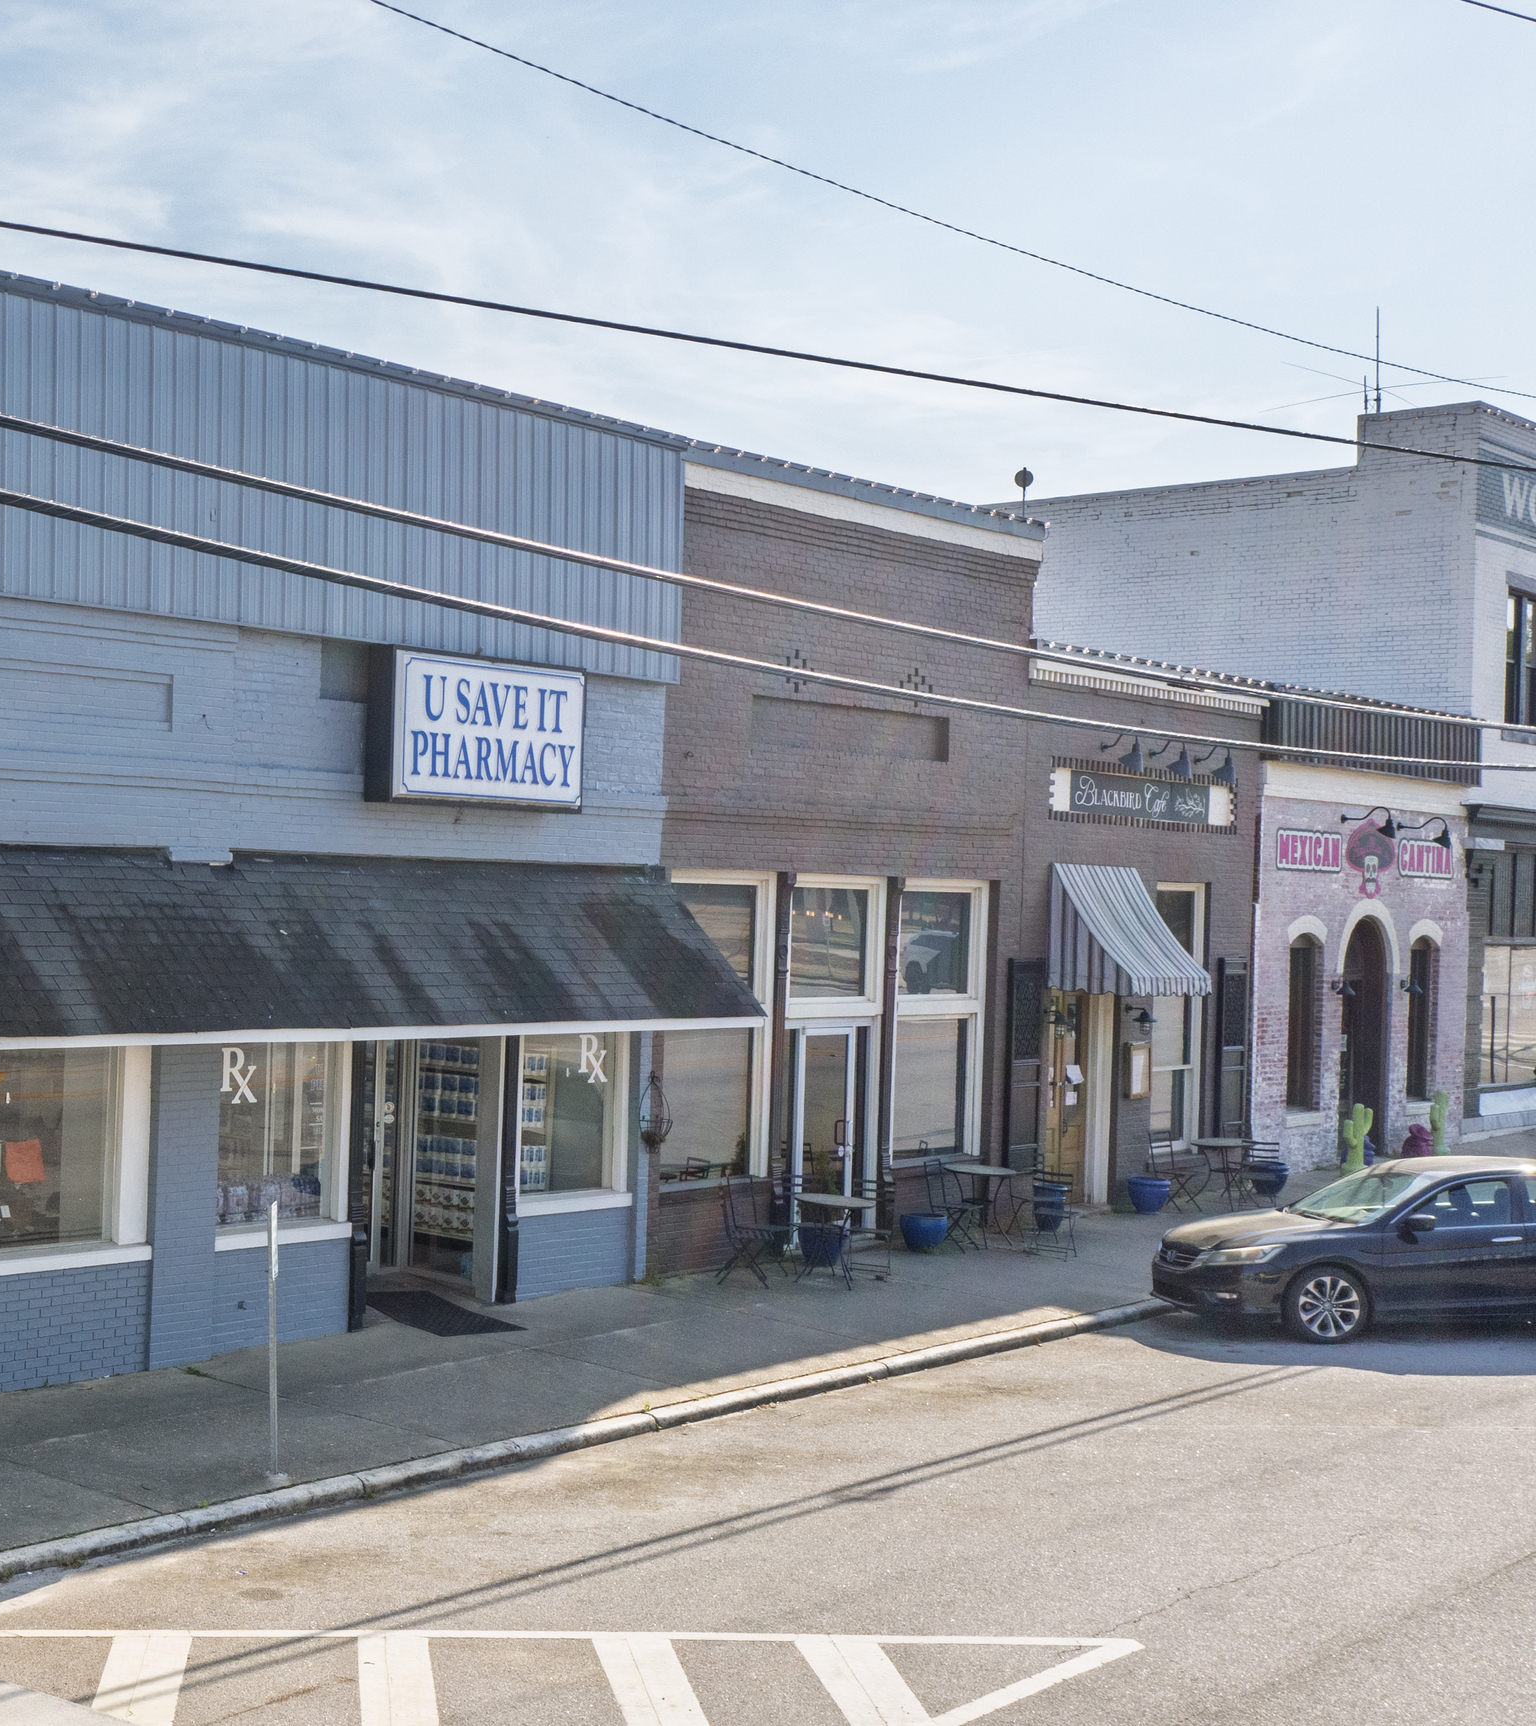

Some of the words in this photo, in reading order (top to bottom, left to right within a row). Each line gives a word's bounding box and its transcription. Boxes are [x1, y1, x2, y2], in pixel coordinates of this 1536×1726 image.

[423, 674, 447, 722] U
[455, 678, 529, 731] SAVE
[537, 688, 568, 734] IT
[410, 730, 576, 788] PHARMACY
[1278, 833, 1340, 868] MEXICAN
[1400, 842, 1452, 876] CANTINA
